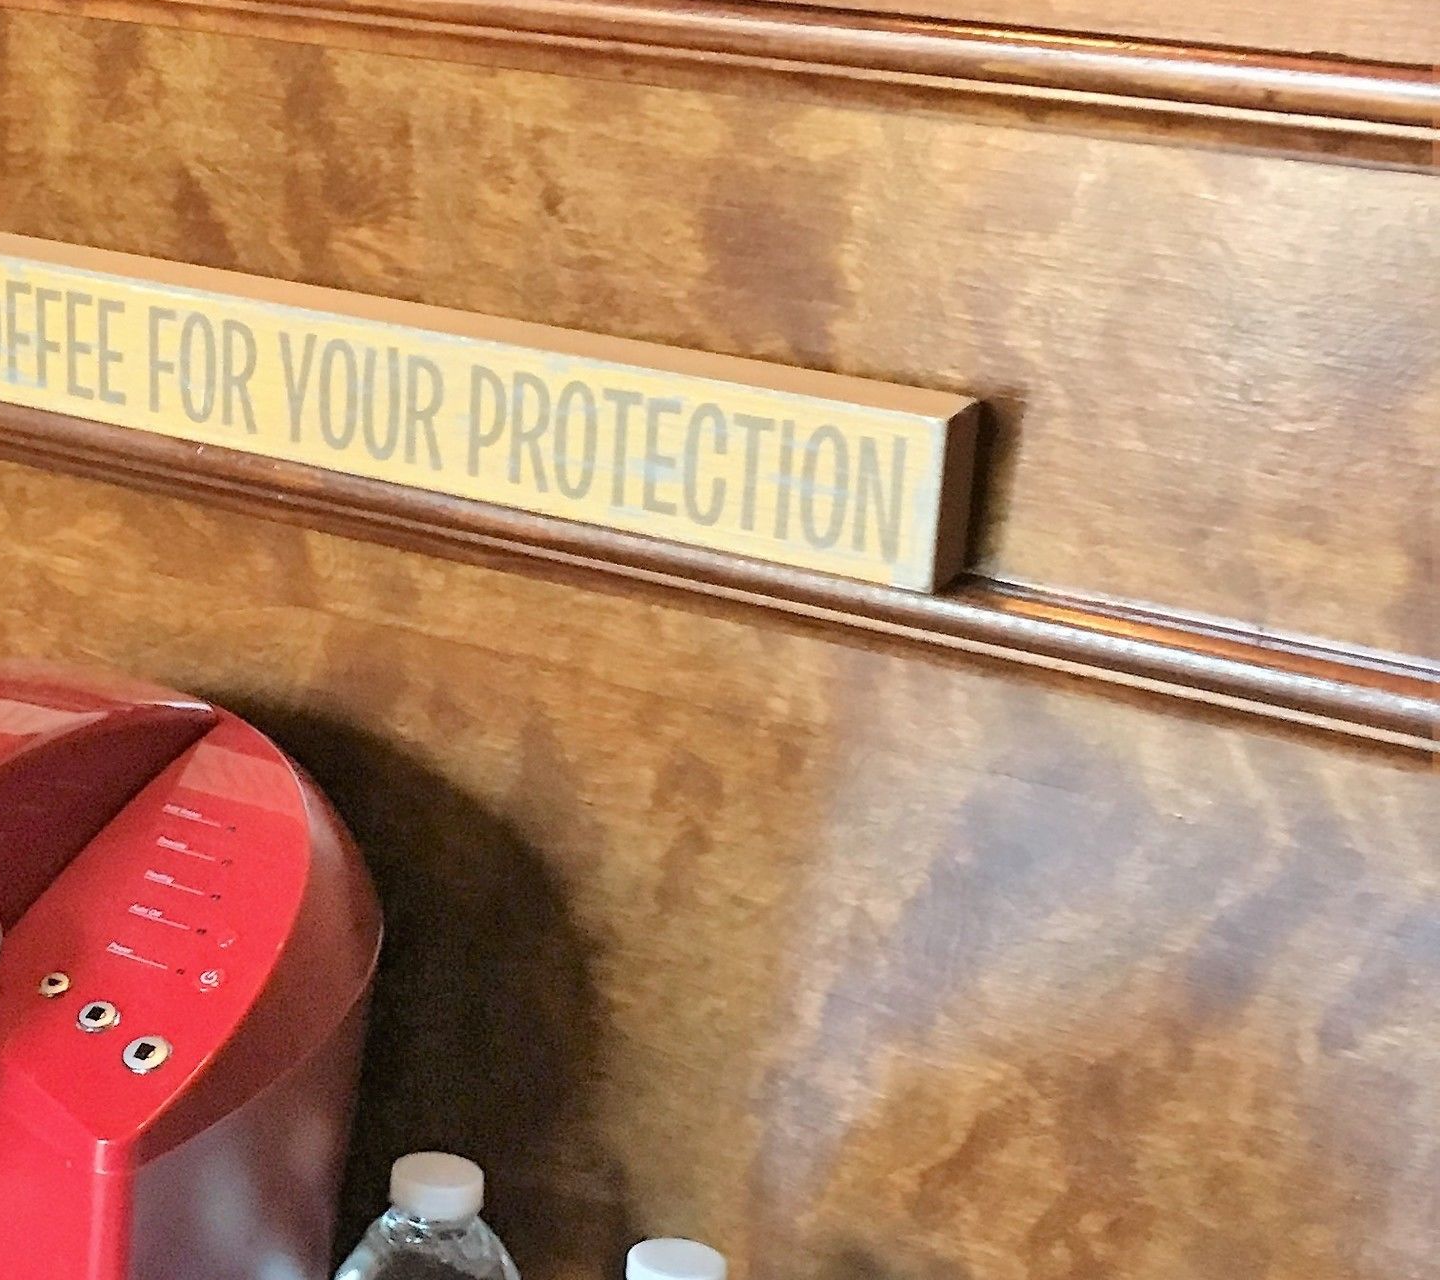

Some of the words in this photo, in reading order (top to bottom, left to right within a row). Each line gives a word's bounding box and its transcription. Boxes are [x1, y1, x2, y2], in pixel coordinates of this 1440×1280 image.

[148, 305, 259, 435] FOR
[280, 331, 444, 472] YOUR
[468, 364, 909, 565] PROTECTION
